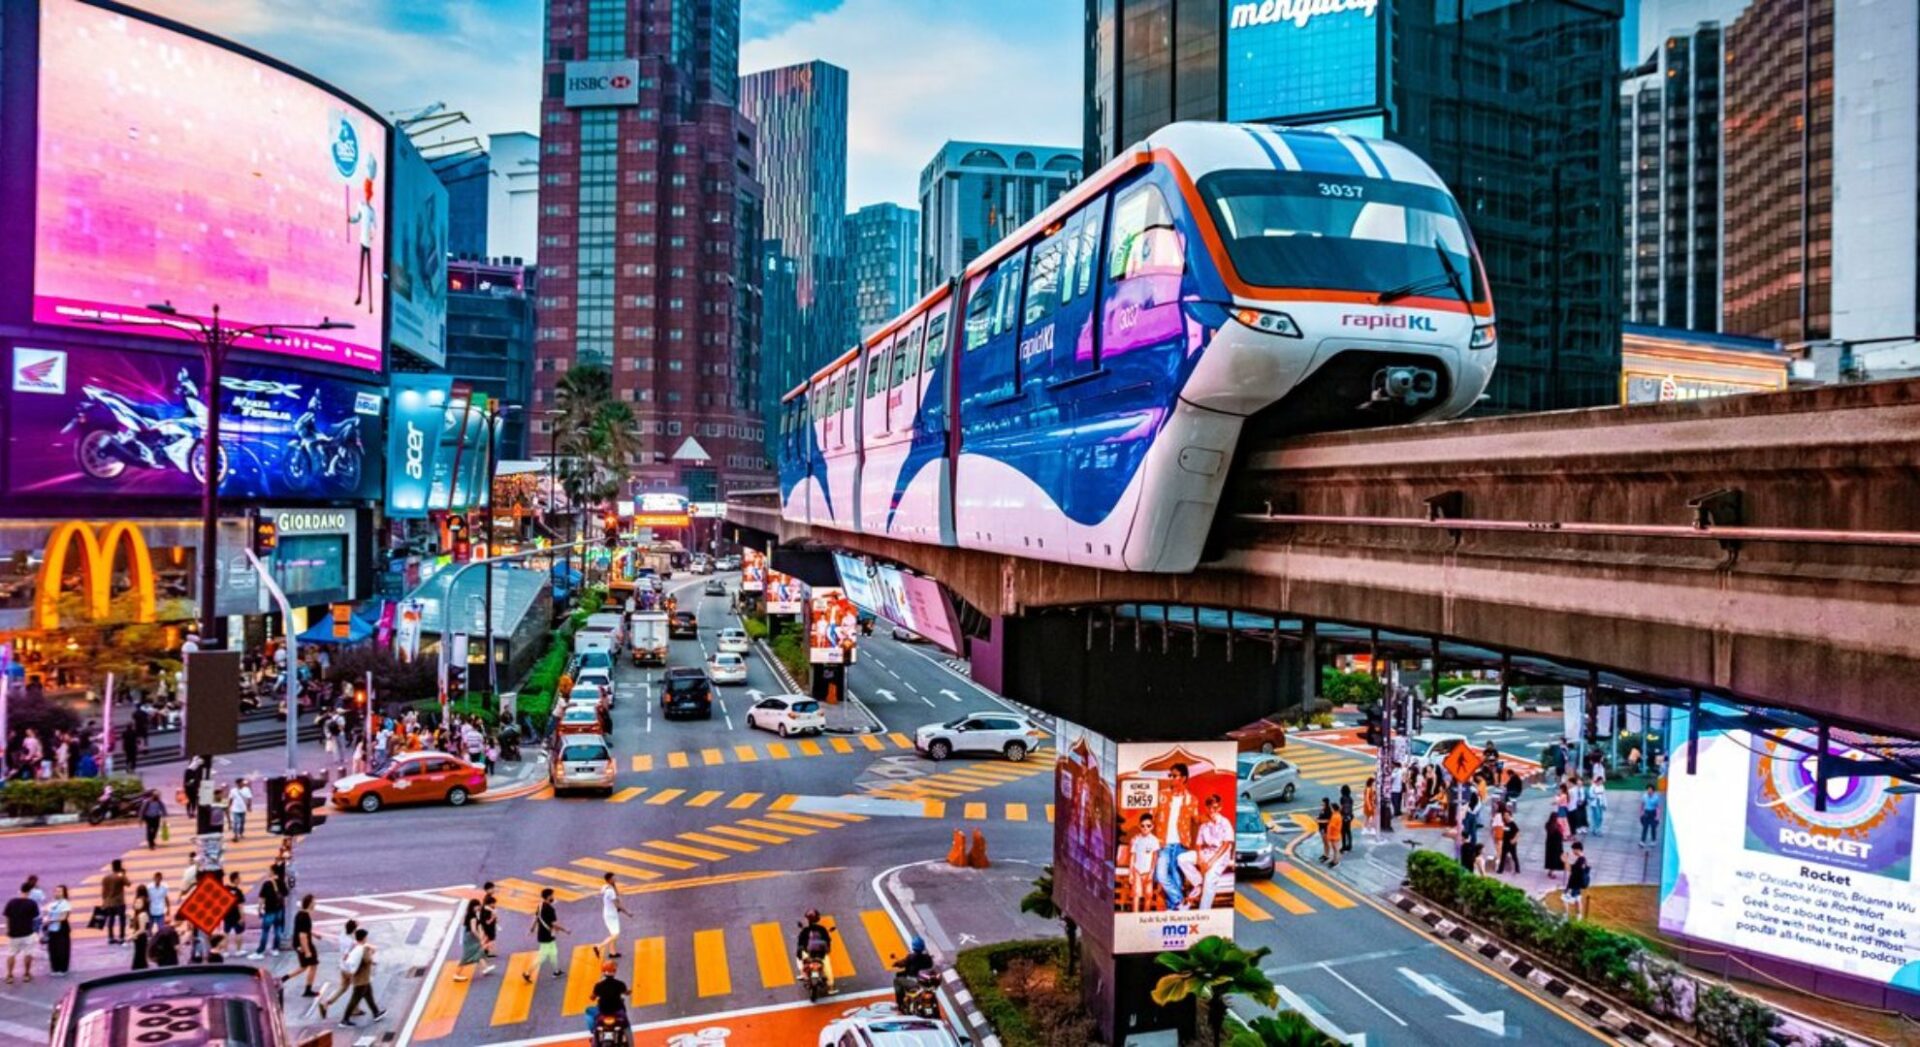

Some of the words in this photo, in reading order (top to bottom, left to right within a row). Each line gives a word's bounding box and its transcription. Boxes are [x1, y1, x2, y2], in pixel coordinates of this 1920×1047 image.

[569, 76, 609, 91] HSBC
[1318, 182, 1364, 198] 3037
[1342, 313, 1437, 332] rapidKL
[405, 421, 424, 479] acer
[279, 512, 345, 531] GIORDANO
[1127, 794, 1153, 807] RM59
[1779, 827, 1873, 860] ROCKET
[1800, 866, 1851, 887] Rocket
[1761, 886, 1769, 896] &
[1773, 887, 1812, 905] Simone
[1814, 898, 1829, 909] de
[1831, 900, 1885, 921] Rochefort
[1851, 891, 1893, 909] Brianna
[1896, 901, 1916, 914] Wu
[1742, 895, 1769, 909] Geek
[1772, 904, 1791, 914] out
[1793, 906, 1825, 922] about
[1826, 914, 1851, 927] tech
[1853, 921, 1876, 933] and
[1877, 927, 1907, 940] geek
[1162, 923, 1199, 936] max
[1743, 909, 1780, 925] culture
[1781, 920, 1805, 929] with
[1806, 923, 1825, 935] the
[1827, 926, 1849, 940] first
[1850, 934, 1873, 945] and
[1874, 939, 1904, 953] most
[1736, 921, 1777, 936] popular
[1834, 942, 1859, 955] tech
[1861, 949, 1908, 966] podcast
